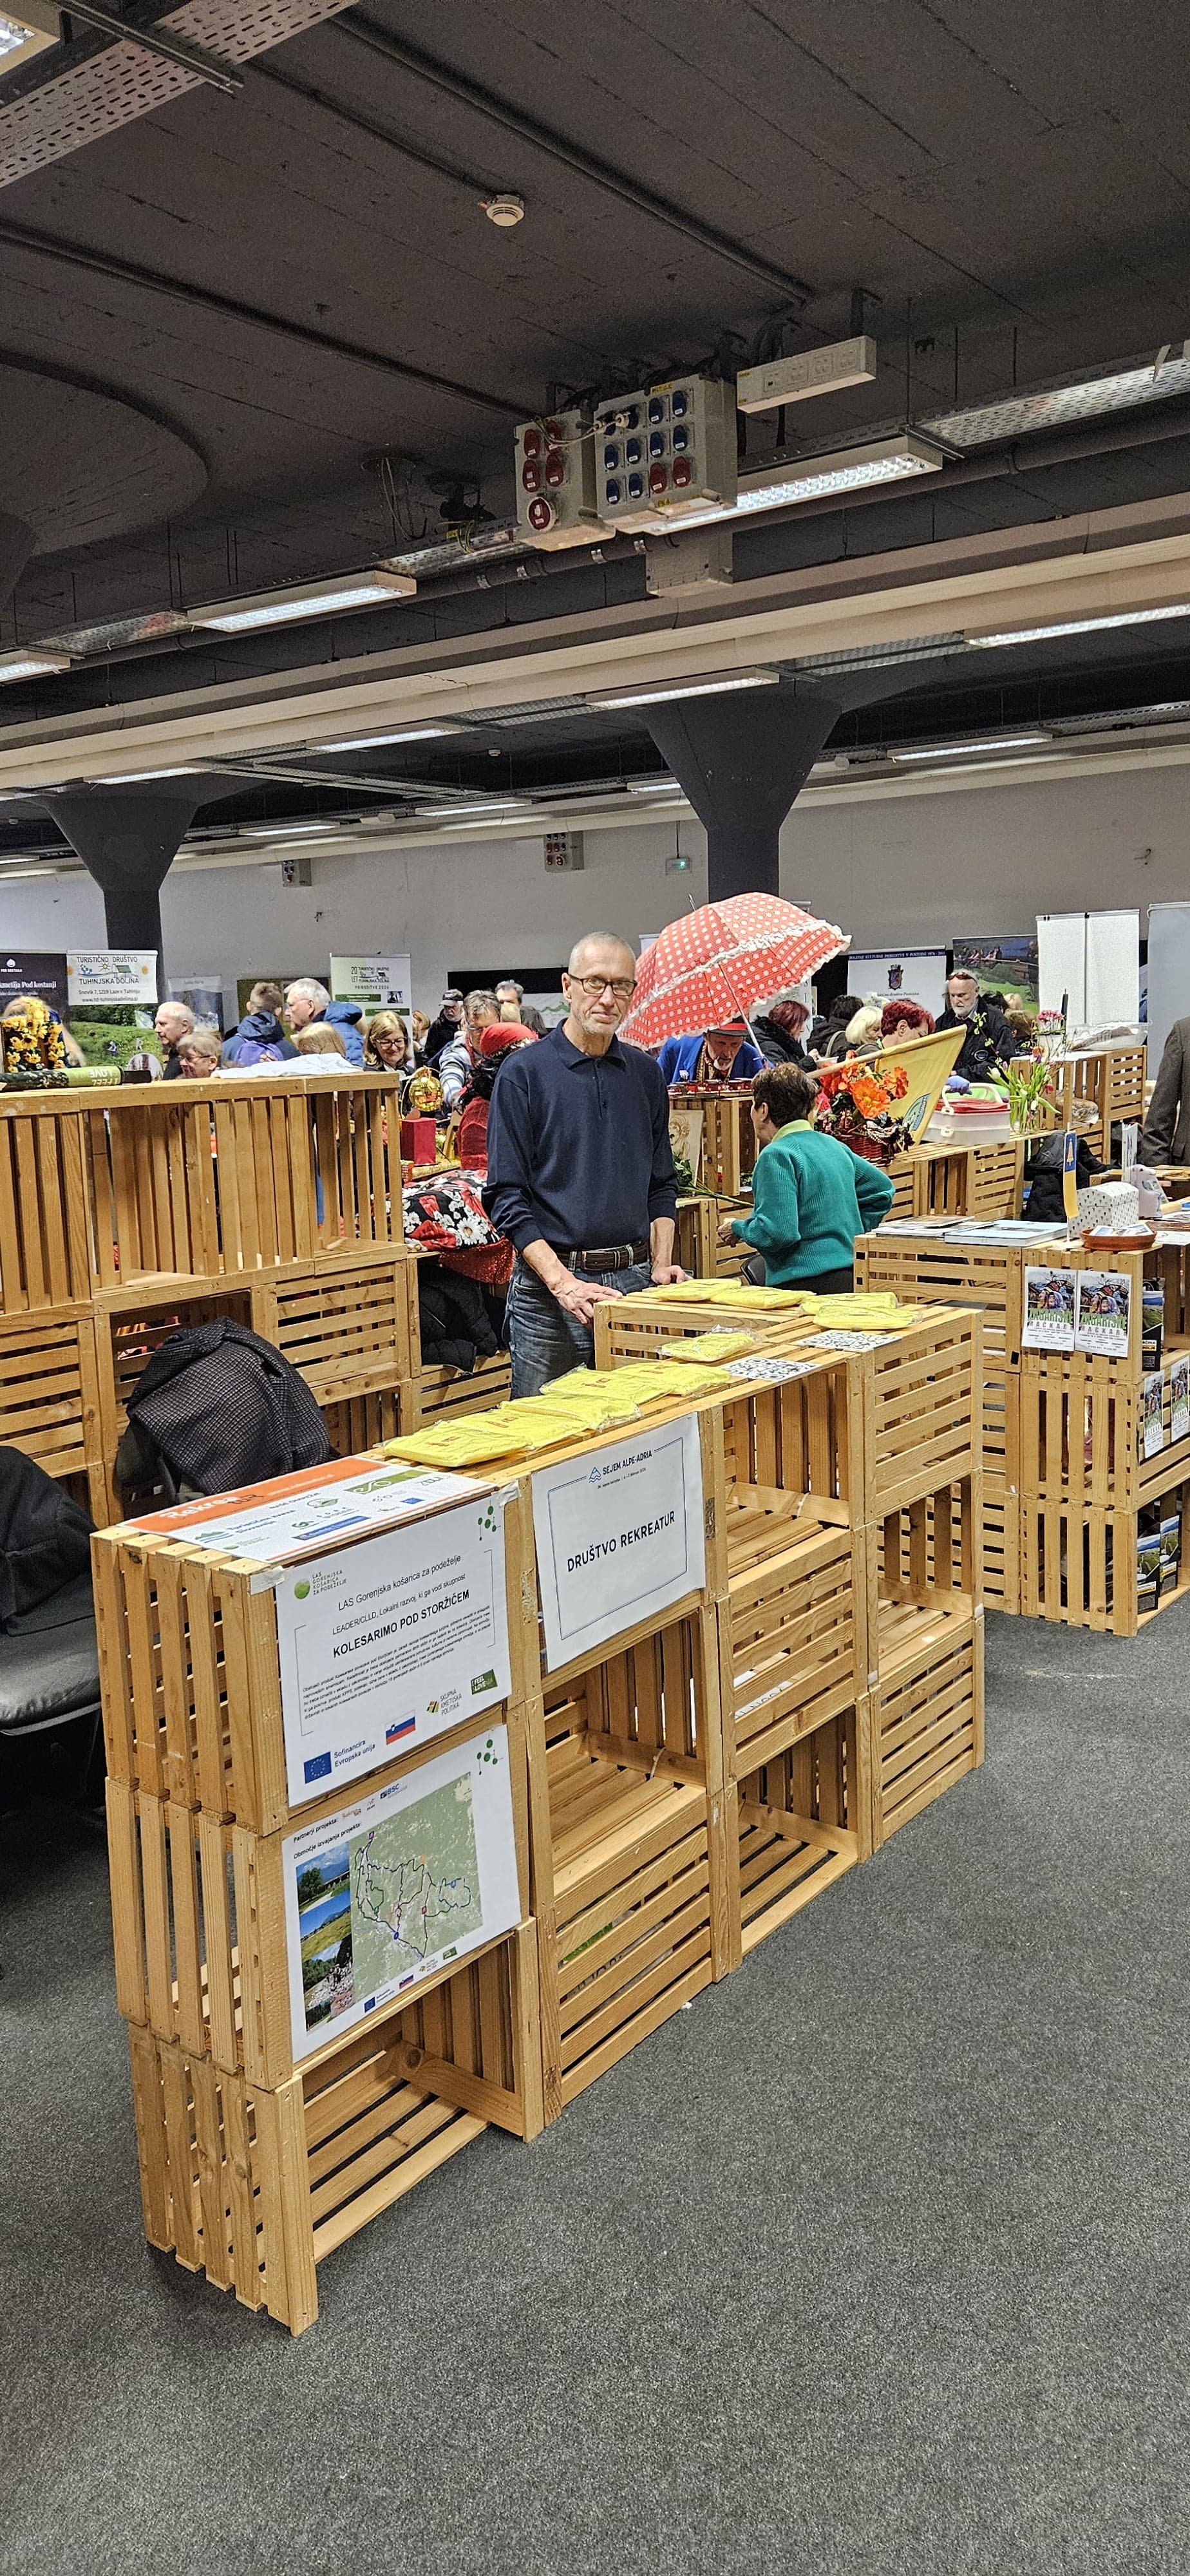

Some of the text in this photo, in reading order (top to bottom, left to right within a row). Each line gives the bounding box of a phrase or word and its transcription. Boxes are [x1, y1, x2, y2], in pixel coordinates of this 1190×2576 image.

[603, 1450, 652, 1475] SEJEM ALPE-ADRIA
[567, 1511, 675, 1572] DRUŠTVO REKREATUR
[312, 1569, 343, 1584] GORENJSKA
[321, 1578, 346, 1592] PODEŽELJE
[338, 1555, 461, 1611] LAS Gorenjska košarica za podeželje
[332, 1611, 379, 1635] LEADER/CLLD,
[379, 1602, 399, 1616] Lokalni
[400, 1595, 417, 1607] razvoj,
[424, 1589, 431, 1598] ga
[431, 1582, 442, 1593] vodi
[443, 1573, 466, 1588] skupnost
[333, 1622, 397, 1658] KOLESARIMO
[400, 1613, 419, 1629] POD
[420, 1589, 469, 1619] STORŽIČEM
[474, 1676, 485, 1685] FEEL
[440, 1689, 457, 1702] SKUPNA
[441, 1702, 460, 1716] POLITIKA
[334, 1740, 366, 1758] Sofinancira
[335, 1743, 376, 1767] Evropska unija
[387, 1783, 400, 1795] BSC
[293, 1818, 339, 1843] Partnerji projekta:
[294, 1844, 316, 1859] Območje
[317, 1833, 340, 1848] izvajanja
